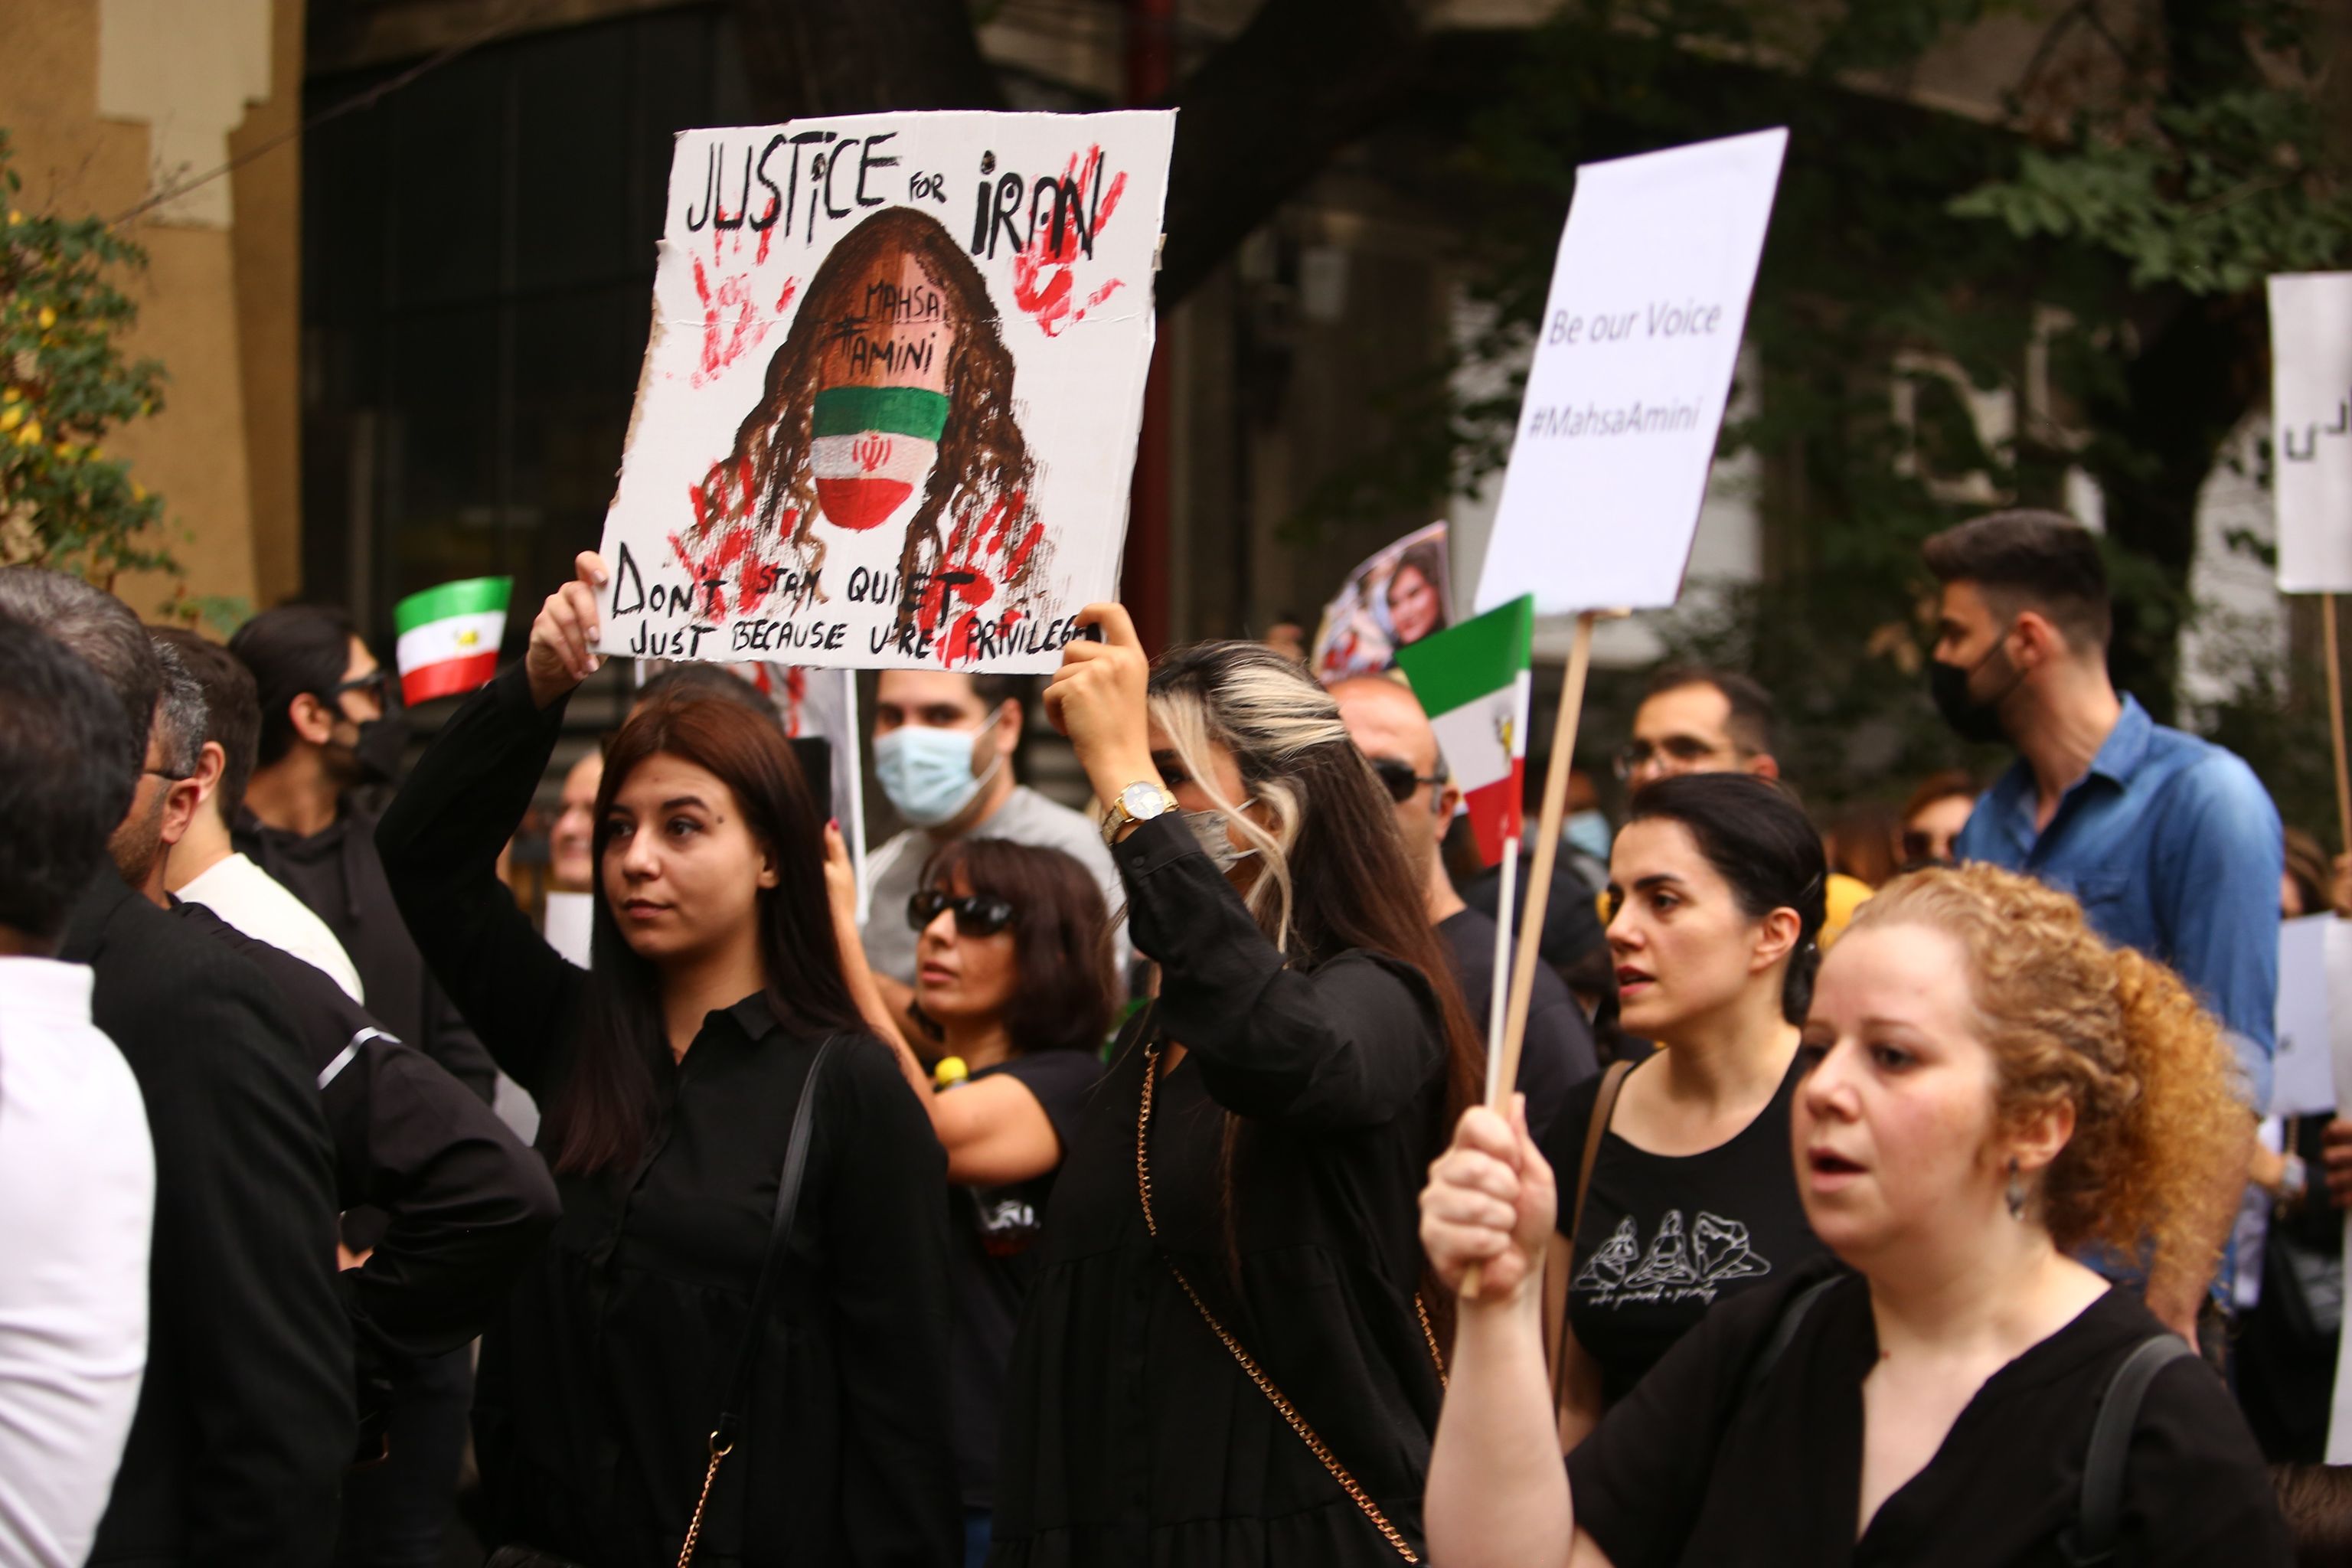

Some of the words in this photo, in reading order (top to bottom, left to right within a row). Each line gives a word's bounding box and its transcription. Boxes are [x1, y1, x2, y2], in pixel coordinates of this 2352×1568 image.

[687, 132, 901, 247] JUSTiCE
[910, 172, 946, 203] FOR
[864, 279, 939, 322] MAHSA
[1549, 309, 1583, 346] Be
[1589, 311, 1639, 342] our
[1647, 298, 1721, 337] Voice
[1529, 400, 1702, 439] #MahsaAmini
[612, 541, 727, 619] DON'T
[756, 565, 822, 612] STAY
[631, 619, 717, 657] JUST
[732, 618, 848, 651] BECAUSE
